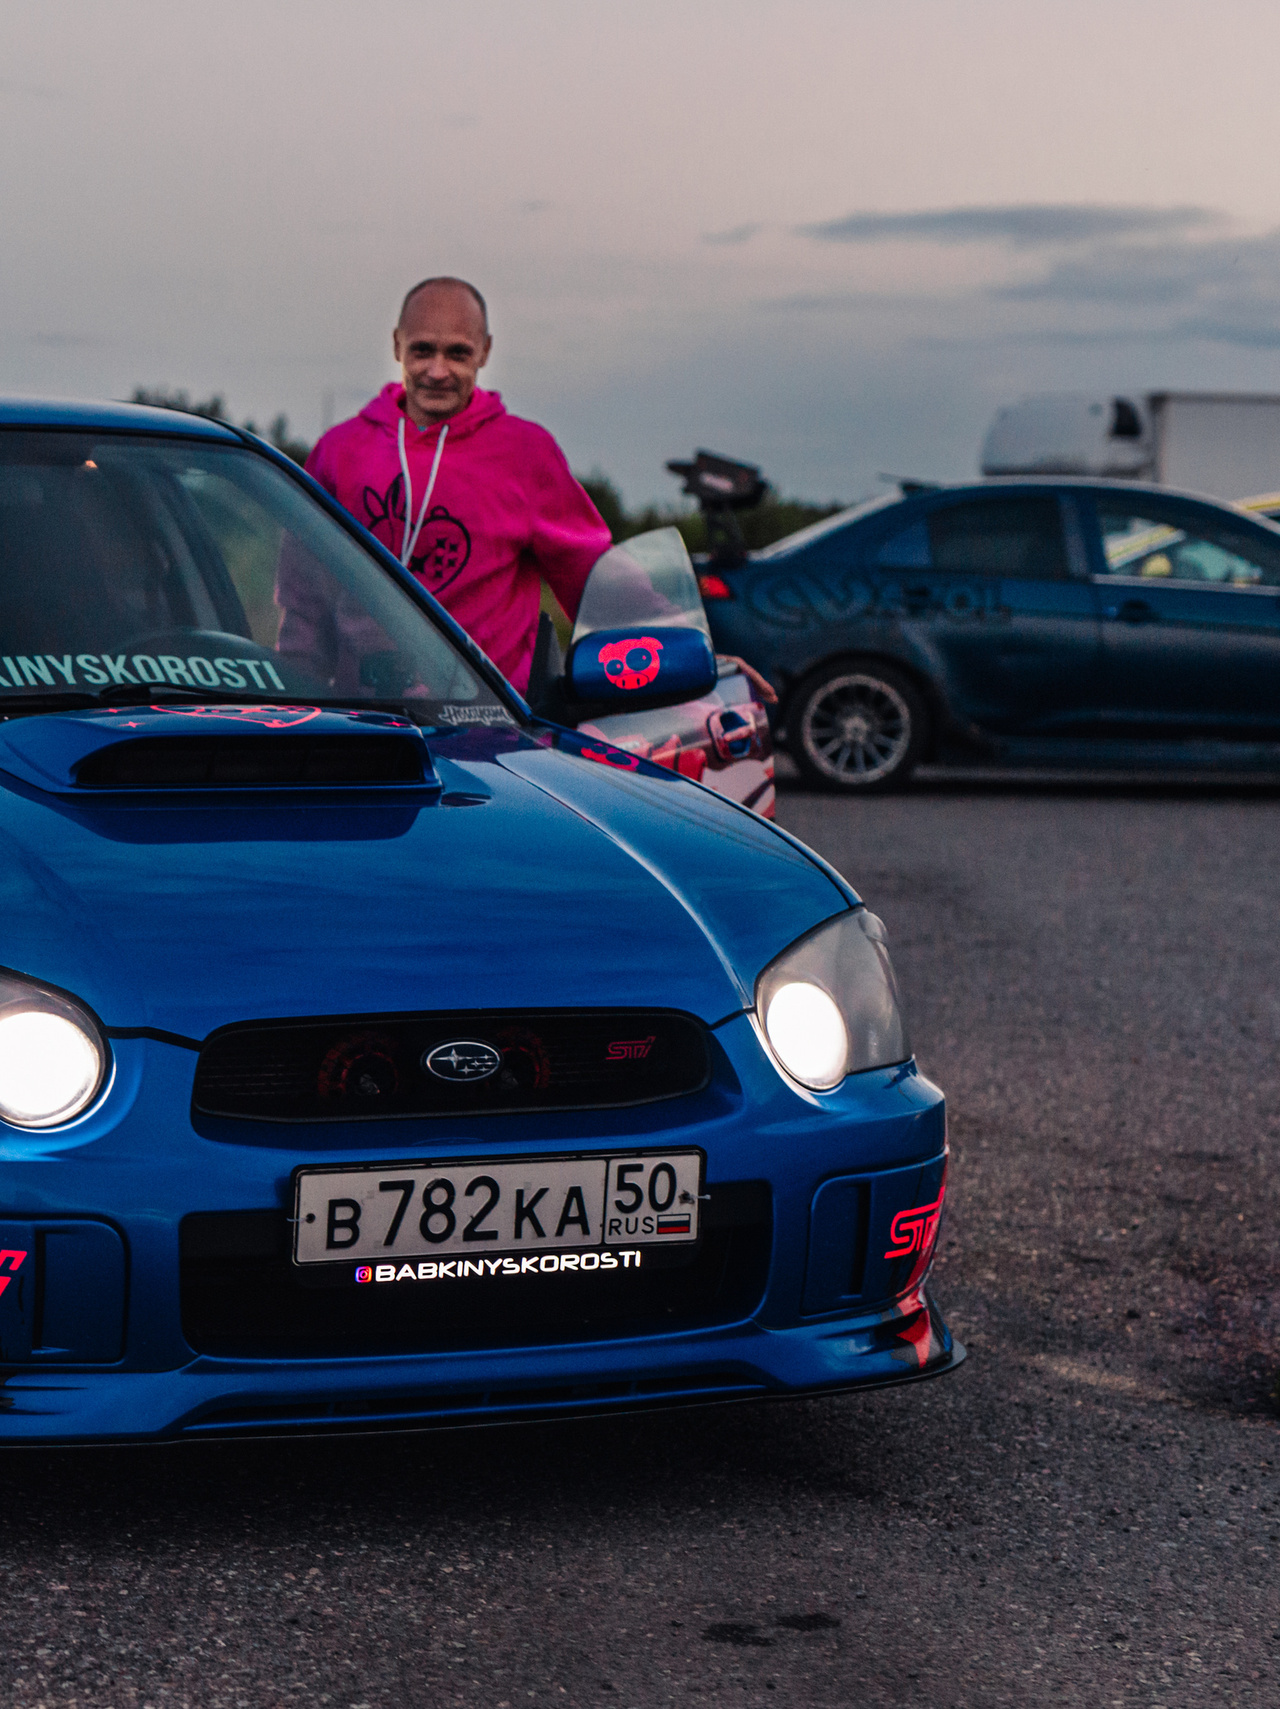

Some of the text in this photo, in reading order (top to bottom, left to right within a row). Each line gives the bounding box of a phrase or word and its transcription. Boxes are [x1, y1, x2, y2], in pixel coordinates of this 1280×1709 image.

[614, 1162, 677, 1213] 50
[608, 1216, 655, 1237] RUS
[375, 1250, 641, 1282] BABKINYSKOROSTI
